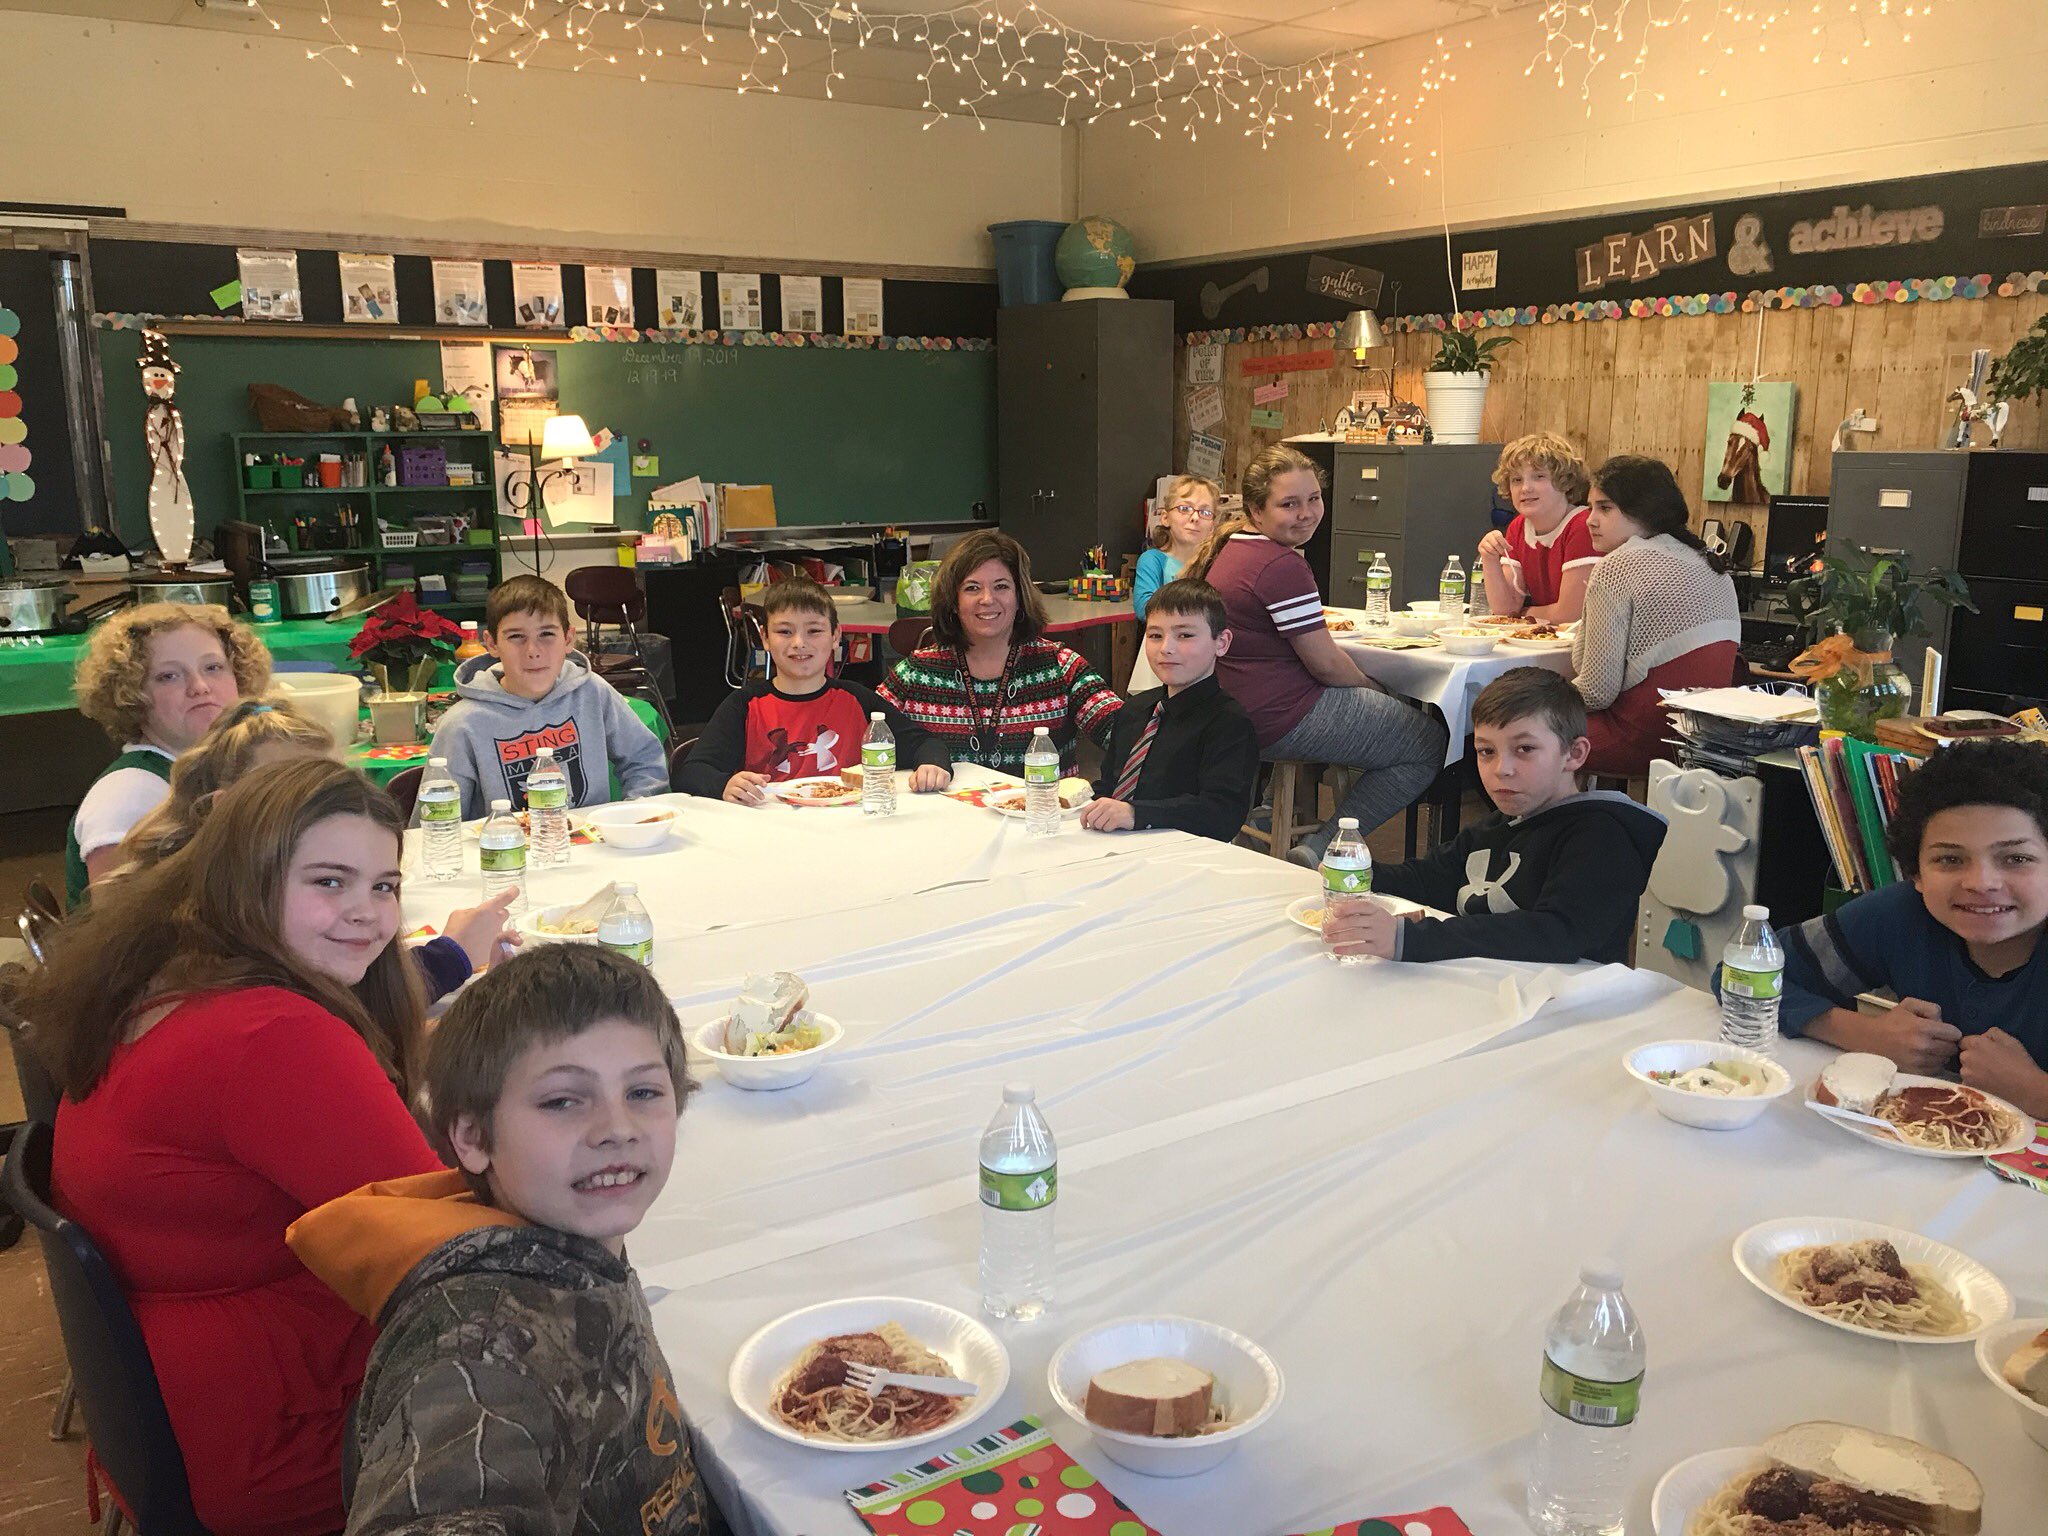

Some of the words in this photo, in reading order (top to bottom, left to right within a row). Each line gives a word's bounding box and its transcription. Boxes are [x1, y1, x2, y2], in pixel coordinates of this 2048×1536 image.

[1584, 218, 1712, 286] LEARN
[1727, 213, 1775, 277] &
[1789, 203, 1945, 255] achieve
[1463, 254, 1496, 271] HAPPY
[1319, 268, 1377, 296] gather
[622, 346, 683, 365] December
[503, 728, 576, 760] STING
[507, 746, 577, 776] MSA
